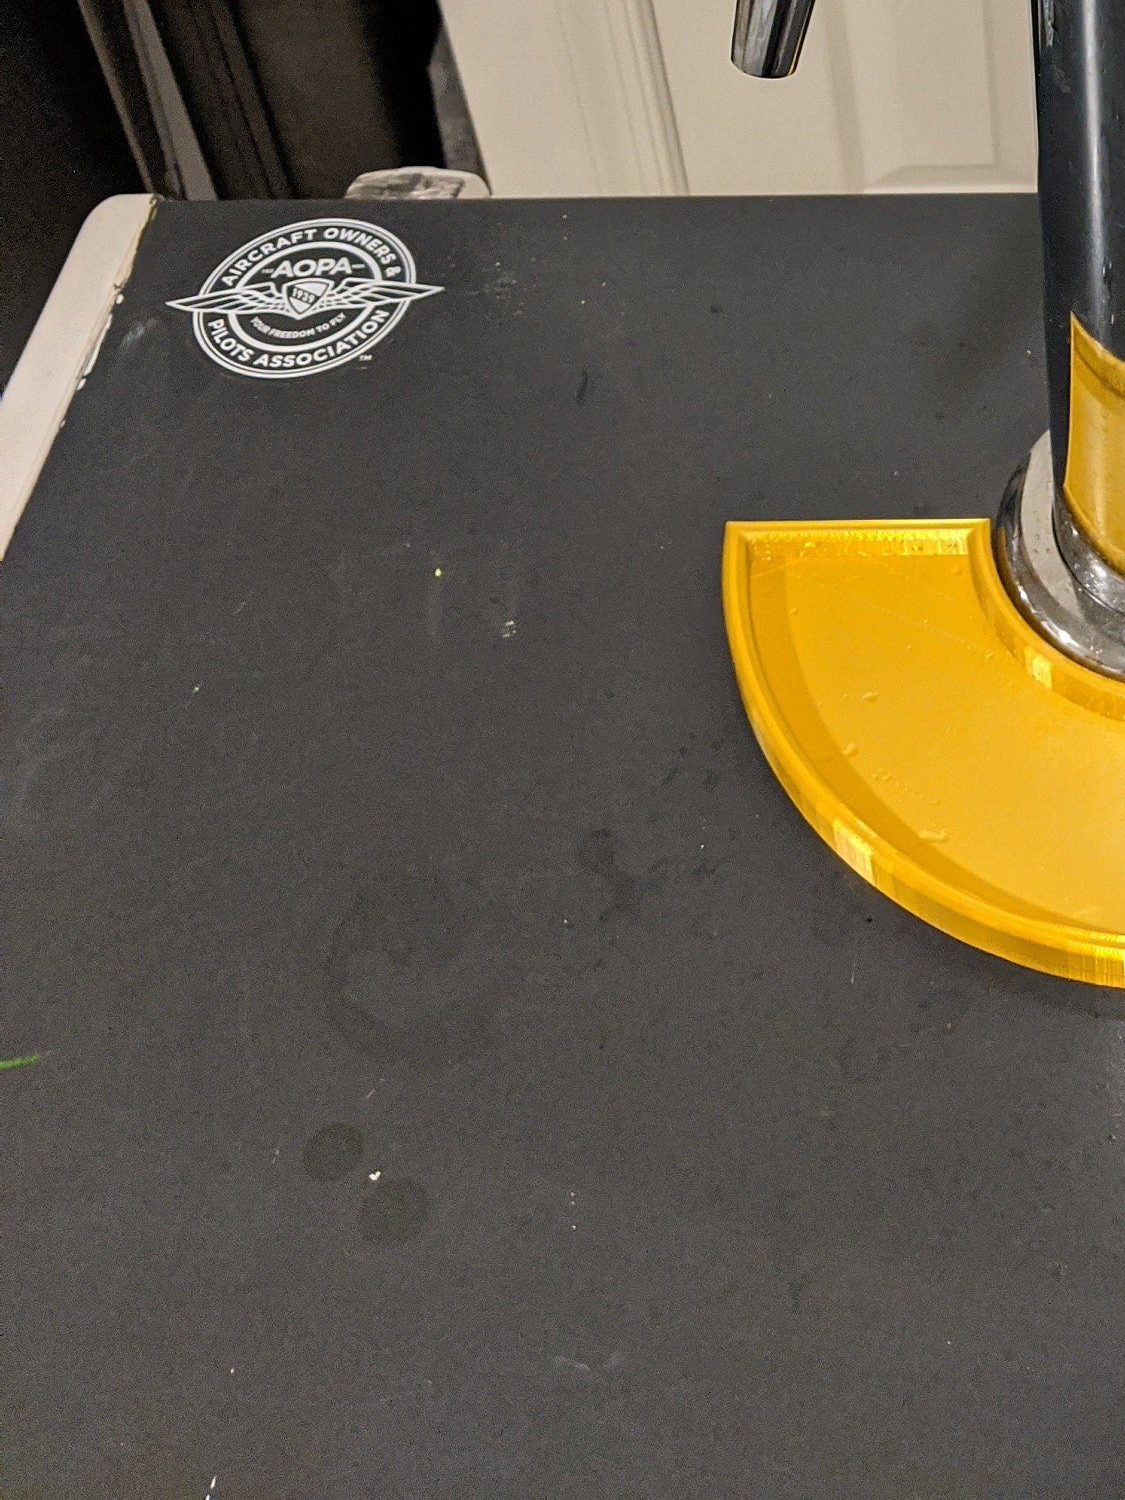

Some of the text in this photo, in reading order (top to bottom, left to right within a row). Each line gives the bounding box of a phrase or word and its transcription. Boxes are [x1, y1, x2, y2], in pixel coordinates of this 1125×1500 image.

[221, 227, 403, 287] AIRCRAFT OWNERS &
[269, 257, 354, 279] AOPA
[291, 287, 316, 304] 1939
[208, 309, 391, 369] PILOTS ASSOCIATION
[250, 312, 347, 339] YOUR FREEDOM TO FLY
